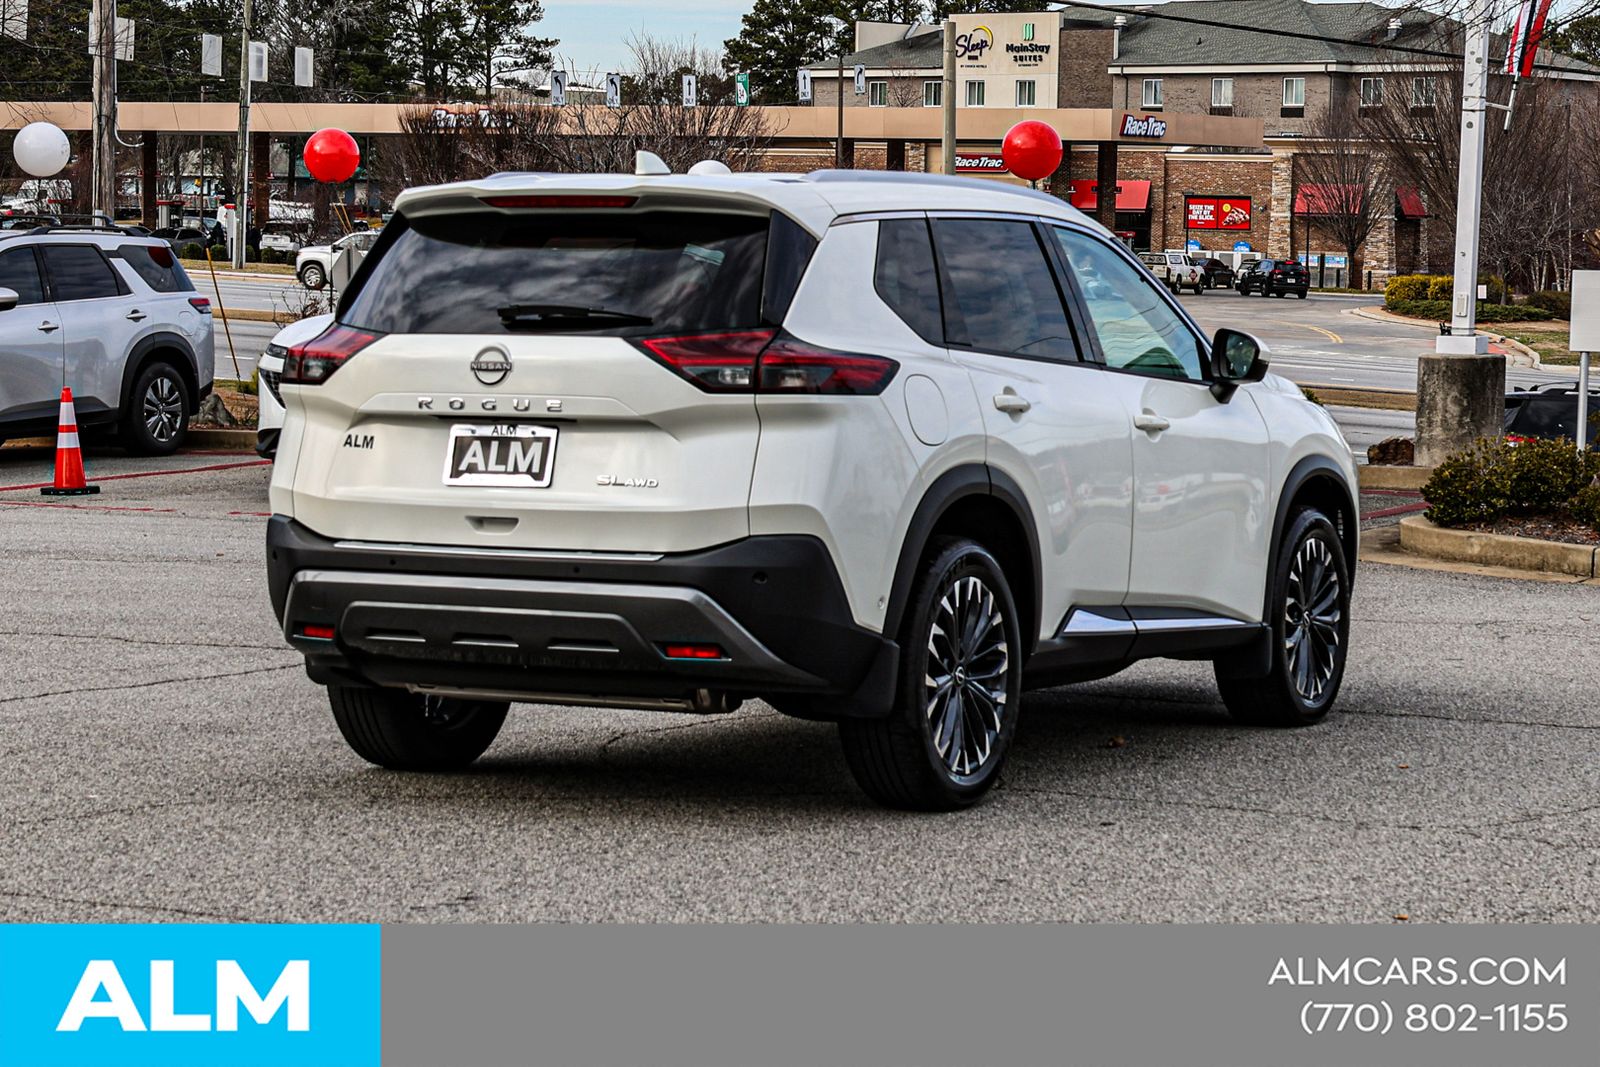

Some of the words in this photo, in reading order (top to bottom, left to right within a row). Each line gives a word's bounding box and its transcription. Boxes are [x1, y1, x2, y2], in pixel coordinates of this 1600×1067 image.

[956, 33, 989, 57] Sleep
[1006, 43, 1050, 54] MainStay
[553, 96, 564, 104] ONLY
[1123, 115, 1166, 137] RaceTrac
[955, 156, 1003, 168] RaceTrac
[471, 362, 511, 371] NISSAN
[417, 396, 563, 413] ROGUE
[491, 425, 517, 437] ALM
[343, 434, 374, 449] ALM
[458, 440, 544, 474] ALM
